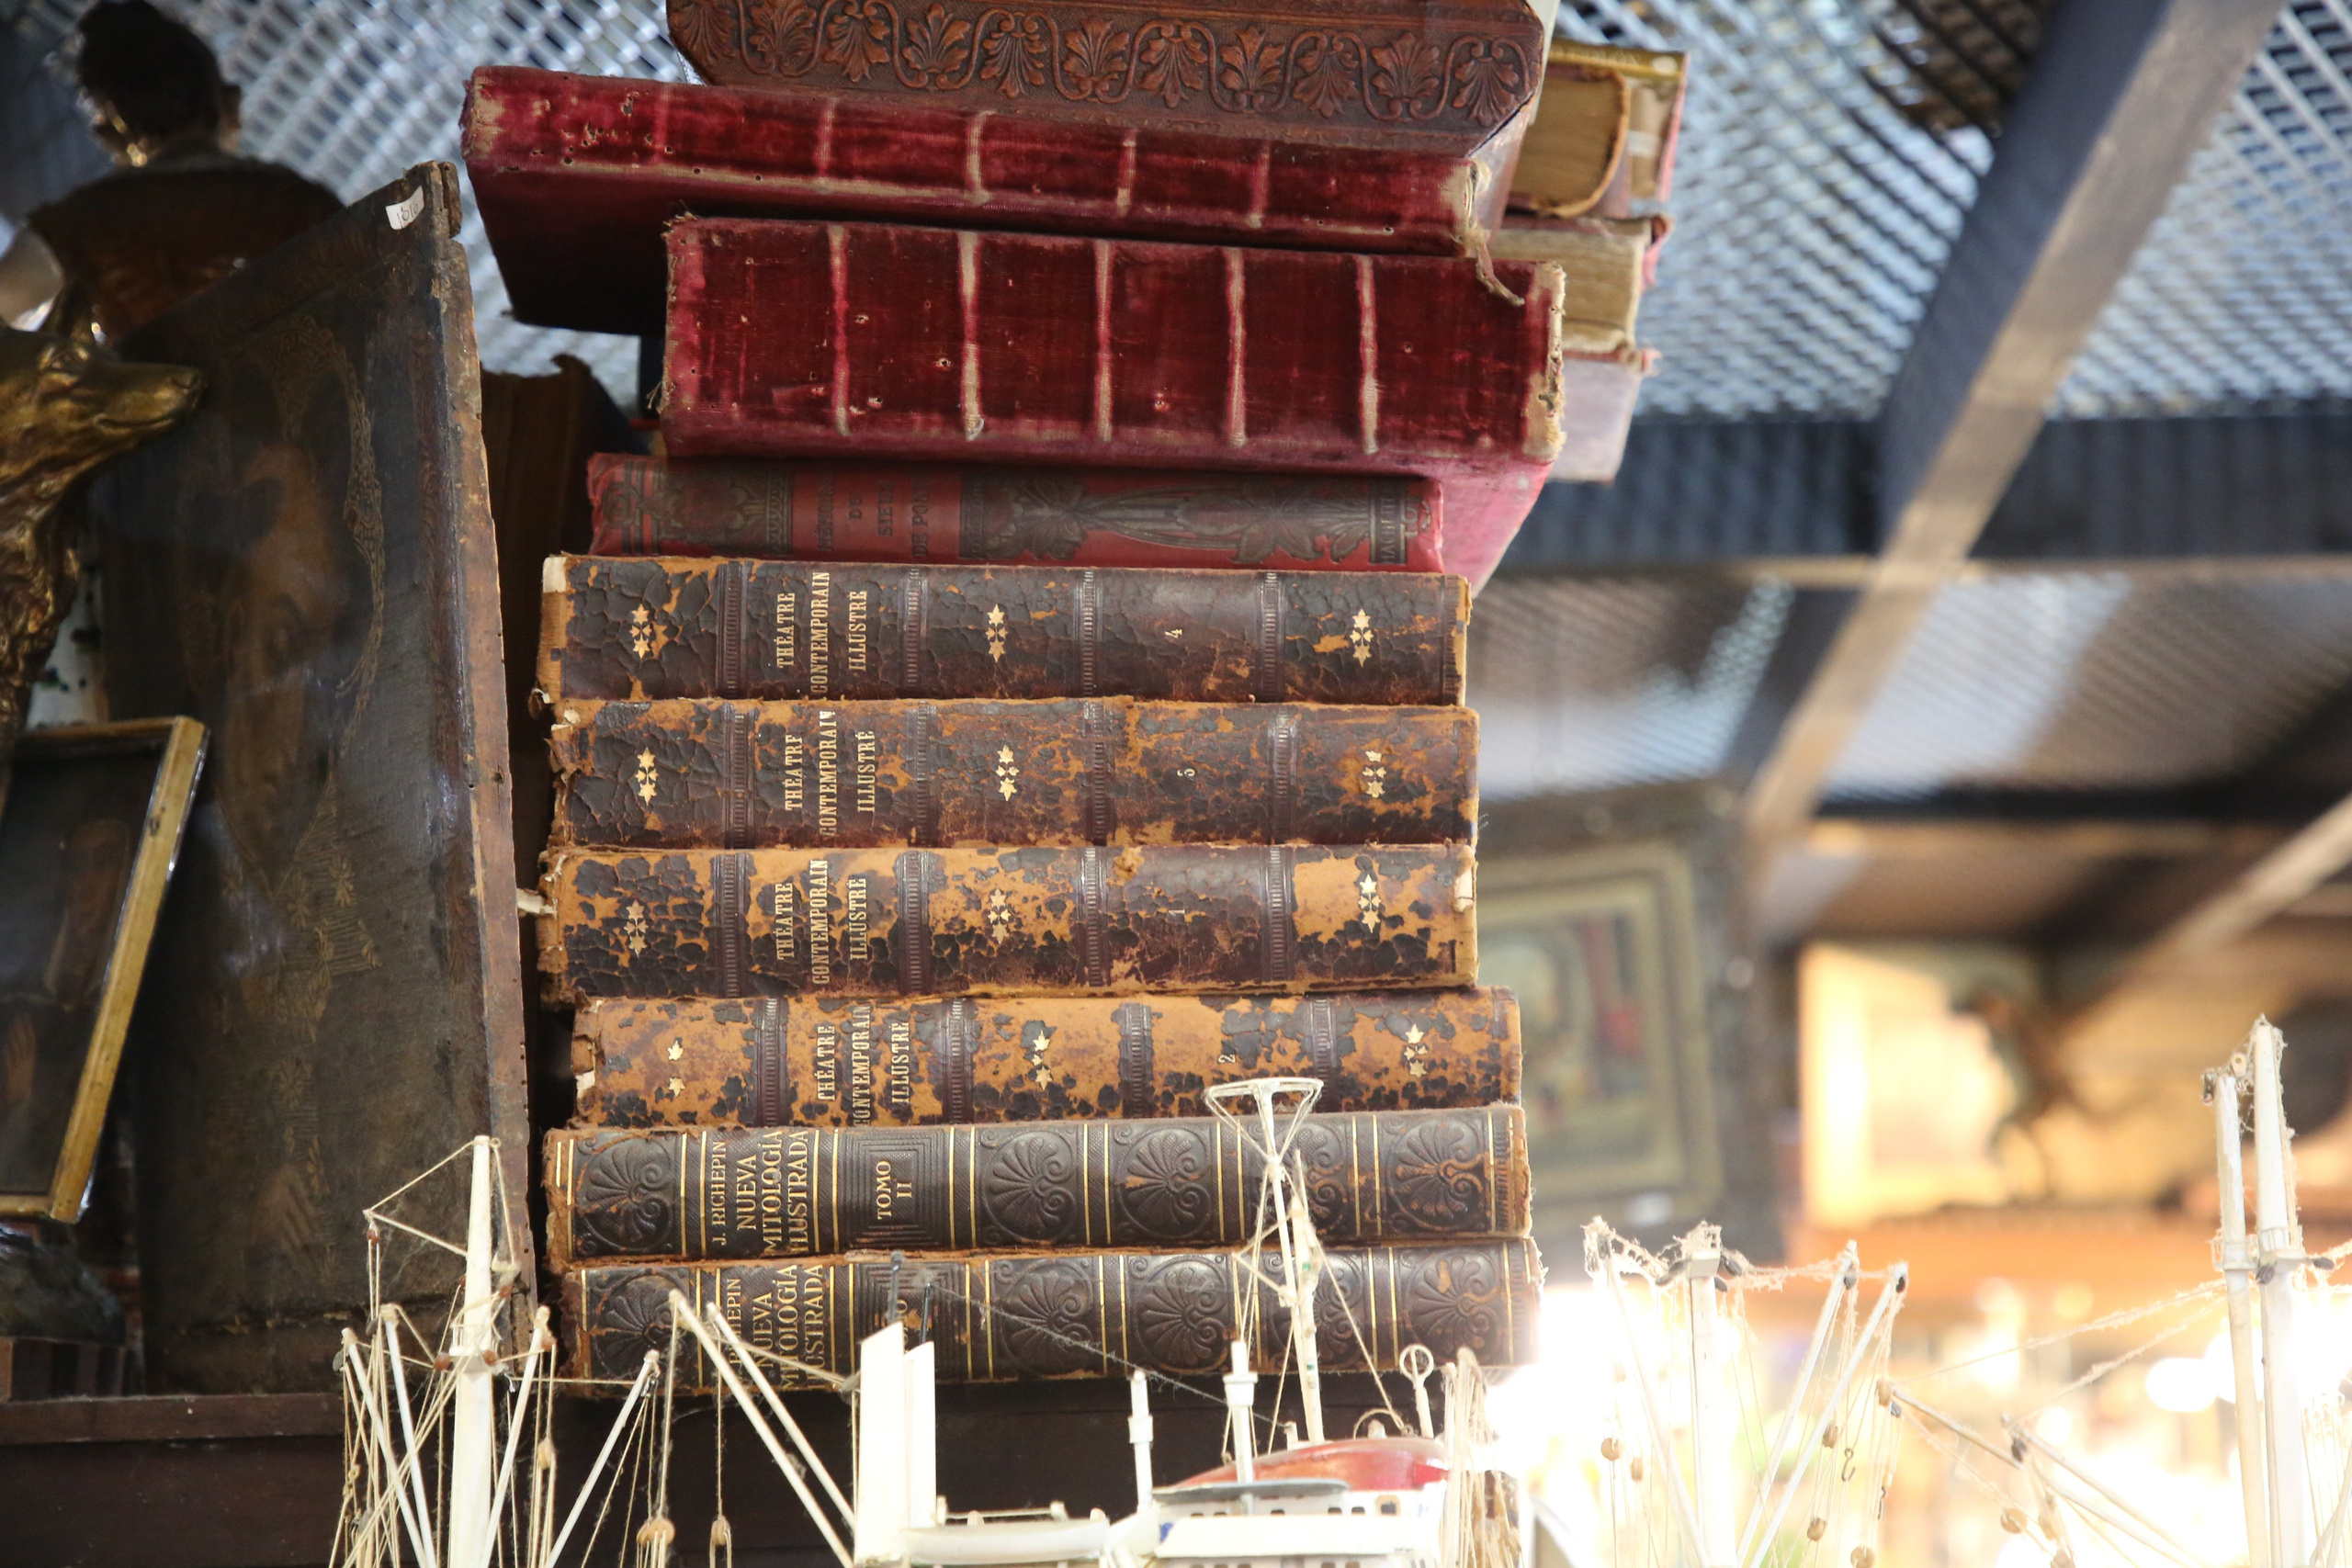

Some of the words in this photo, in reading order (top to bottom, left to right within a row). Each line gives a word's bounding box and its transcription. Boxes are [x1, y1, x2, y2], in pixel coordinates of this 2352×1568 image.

[810, 571, 831, 694] CONTEMPORAIN
[1164, 628, 1182, 639] 4
[819, 710, 837, 837] CONTEMPORAIN
[854, 730, 876, 813] ILLUSTRÉ
[773, 883, 795, 961] THÉATRE
[809, 860, 831, 985] CONTEMPORAIN
[846, 878, 868, 960] ILLUSTRÉ
[888, 1021, 910, 1104] ILLUSTRÉ
[1217, 1054, 1237, 1064] 2
[711, 1142, 727, 1226] RICHEPIN
[737, 1154, 757, 1231] NUEVA
[758, 1131, 783, 1253] MITOLOGÍA
[876, 1160, 893, 1220] TOMO
[897, 1181, 913, 1199] II
[712, 1233, 727, 1247] J.
[727, 1278, 742, 1365] RHEPIN
[752, 1292, 774, 1368] NUEVA
